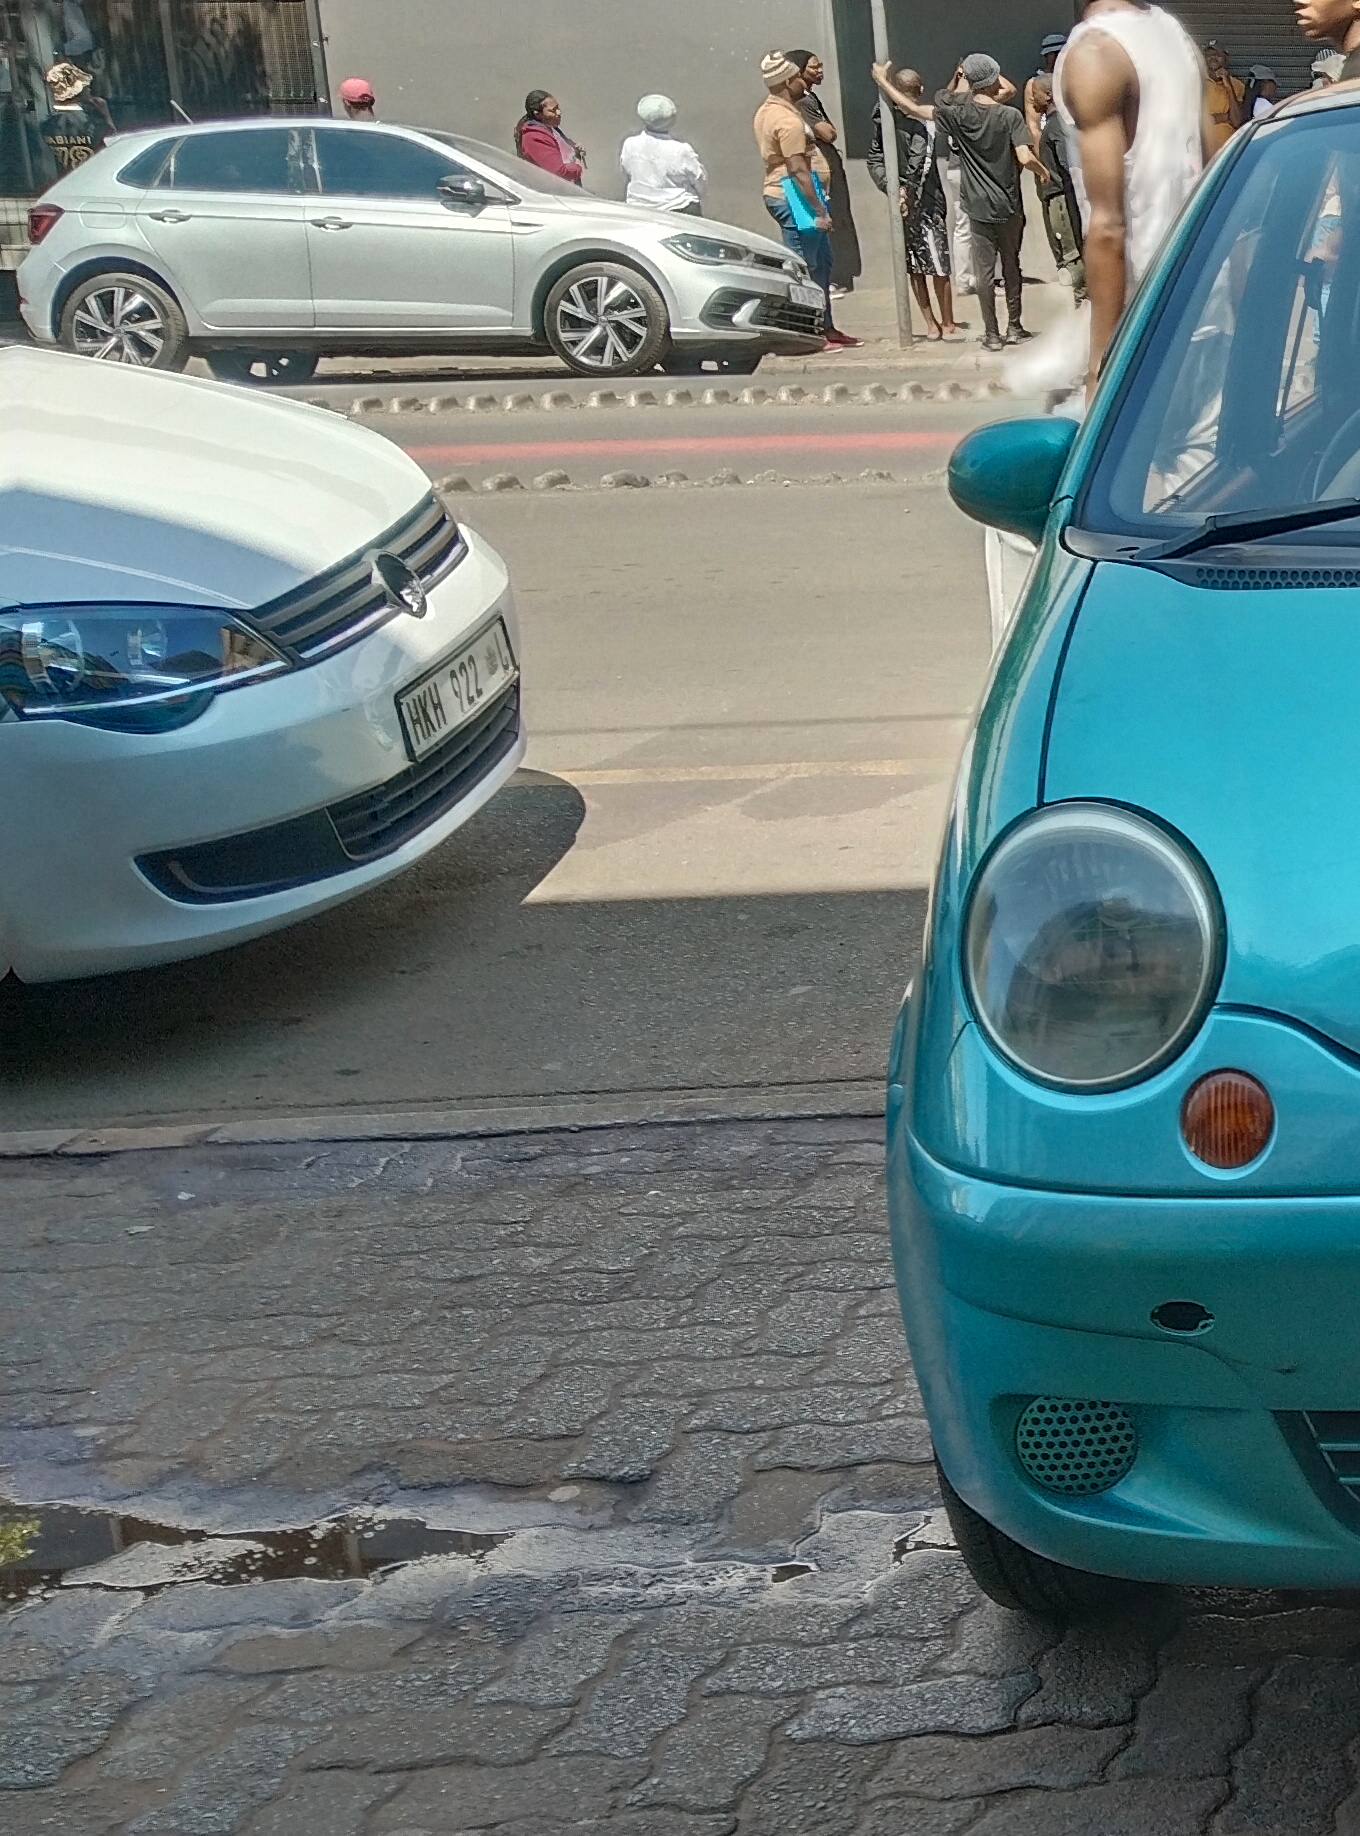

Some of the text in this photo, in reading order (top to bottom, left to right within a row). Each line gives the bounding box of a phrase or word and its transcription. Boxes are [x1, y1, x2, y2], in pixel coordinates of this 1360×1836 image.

[44, 135, 92, 145] ABIANI
[406, 681, 449, 746] HKH
[449, 654, 484, 715] 922
